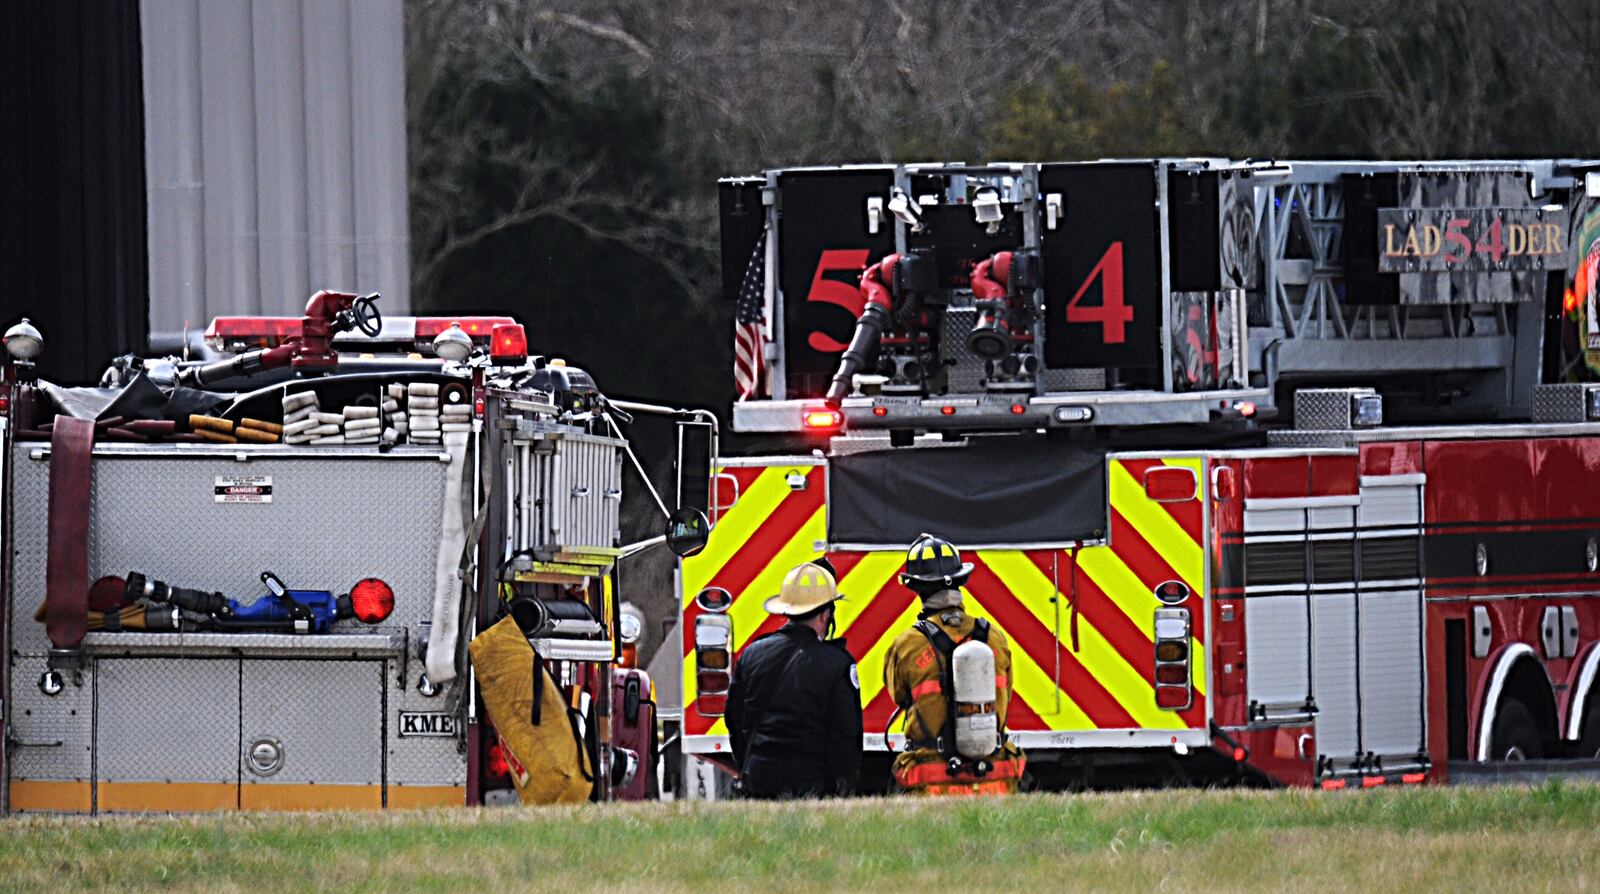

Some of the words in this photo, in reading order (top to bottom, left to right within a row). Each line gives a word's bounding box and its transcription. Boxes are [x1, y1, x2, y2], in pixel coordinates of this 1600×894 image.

[807, 249, 871, 352] 5
[1066, 241, 1134, 344] 4
[403, 714, 454, 733] KME
